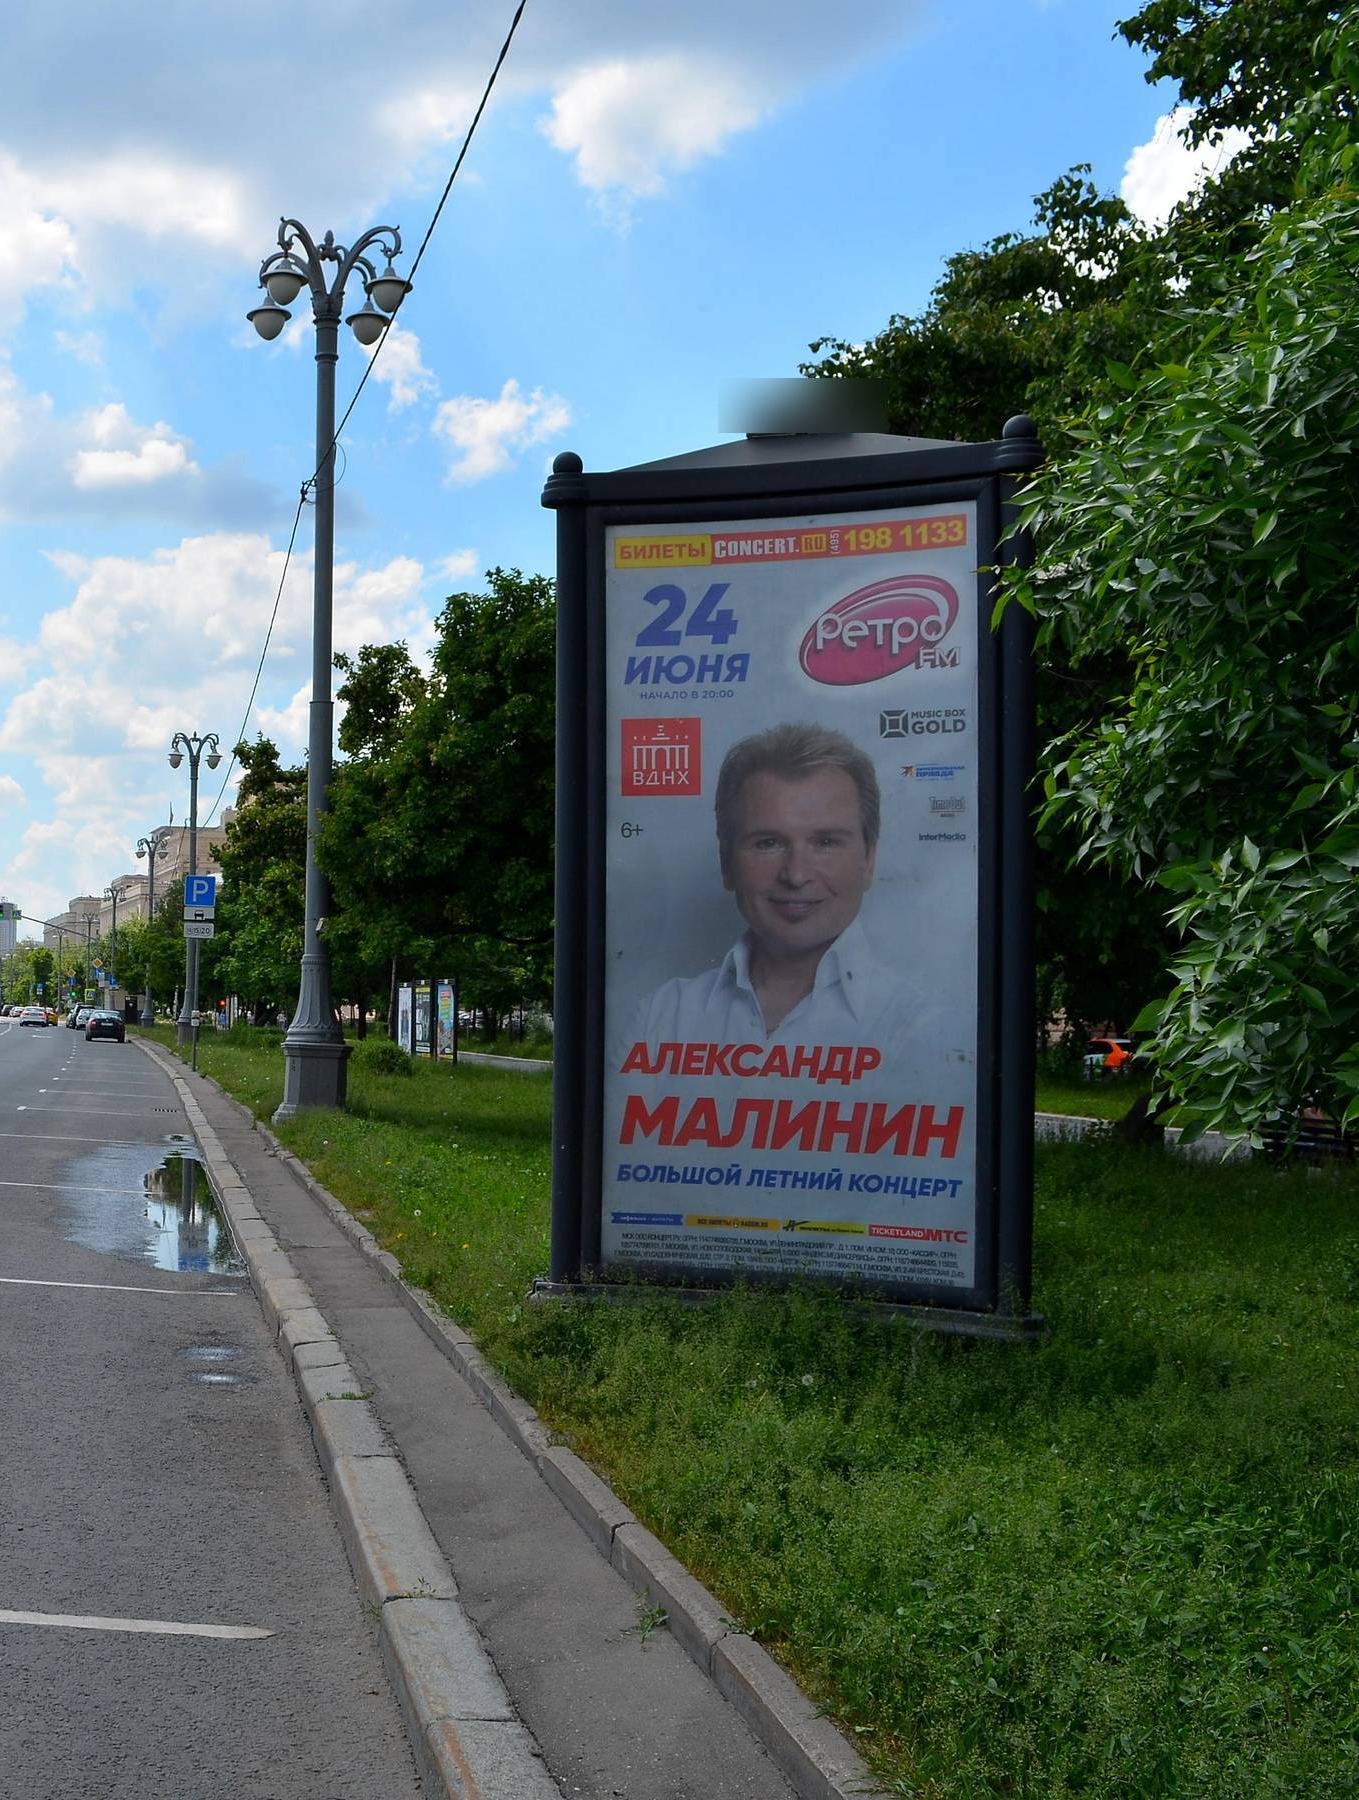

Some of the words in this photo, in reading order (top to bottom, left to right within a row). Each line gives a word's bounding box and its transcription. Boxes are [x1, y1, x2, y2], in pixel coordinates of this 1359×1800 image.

[829, 529, 841, 555] (495)
[844, 527, 892, 551] 198
[899, 520, 965, 546] 1133
[620, 543, 705, 560] БИЛЕТЫ
[635, 583, 738, 647] 24
[915, 647, 961, 669] FM
[624, 653, 750, 685] ИЮНЯ
[641, 690, 688, 700] НАЧАЛО
[692, 690, 699, 699] В
[703, 689, 734, 699] 20:00
[911, 710, 942, 719] MUSIC
[945, 708, 966, 717] BOX
[911, 719, 966, 735] GOLD
[633, 770, 690, 786] ВДНХ
[620, 822, 644, 839] 6+
[192, 879, 209, 902] P
[620, 1042, 882, 1085] АЛЕКСАНДР
[619, 1095, 965, 1158] МАЛИНИН
[617, 1163, 742, 1187] БОЛЬШОЙ
[746, 1168, 843, 1192] ЛЕТНИЙ
[848, 1174, 963, 1198] КОНЦЕРТ
[871, 1226, 925, 1239] TICKETLAND
[926, 1229, 969, 1244] МТС
